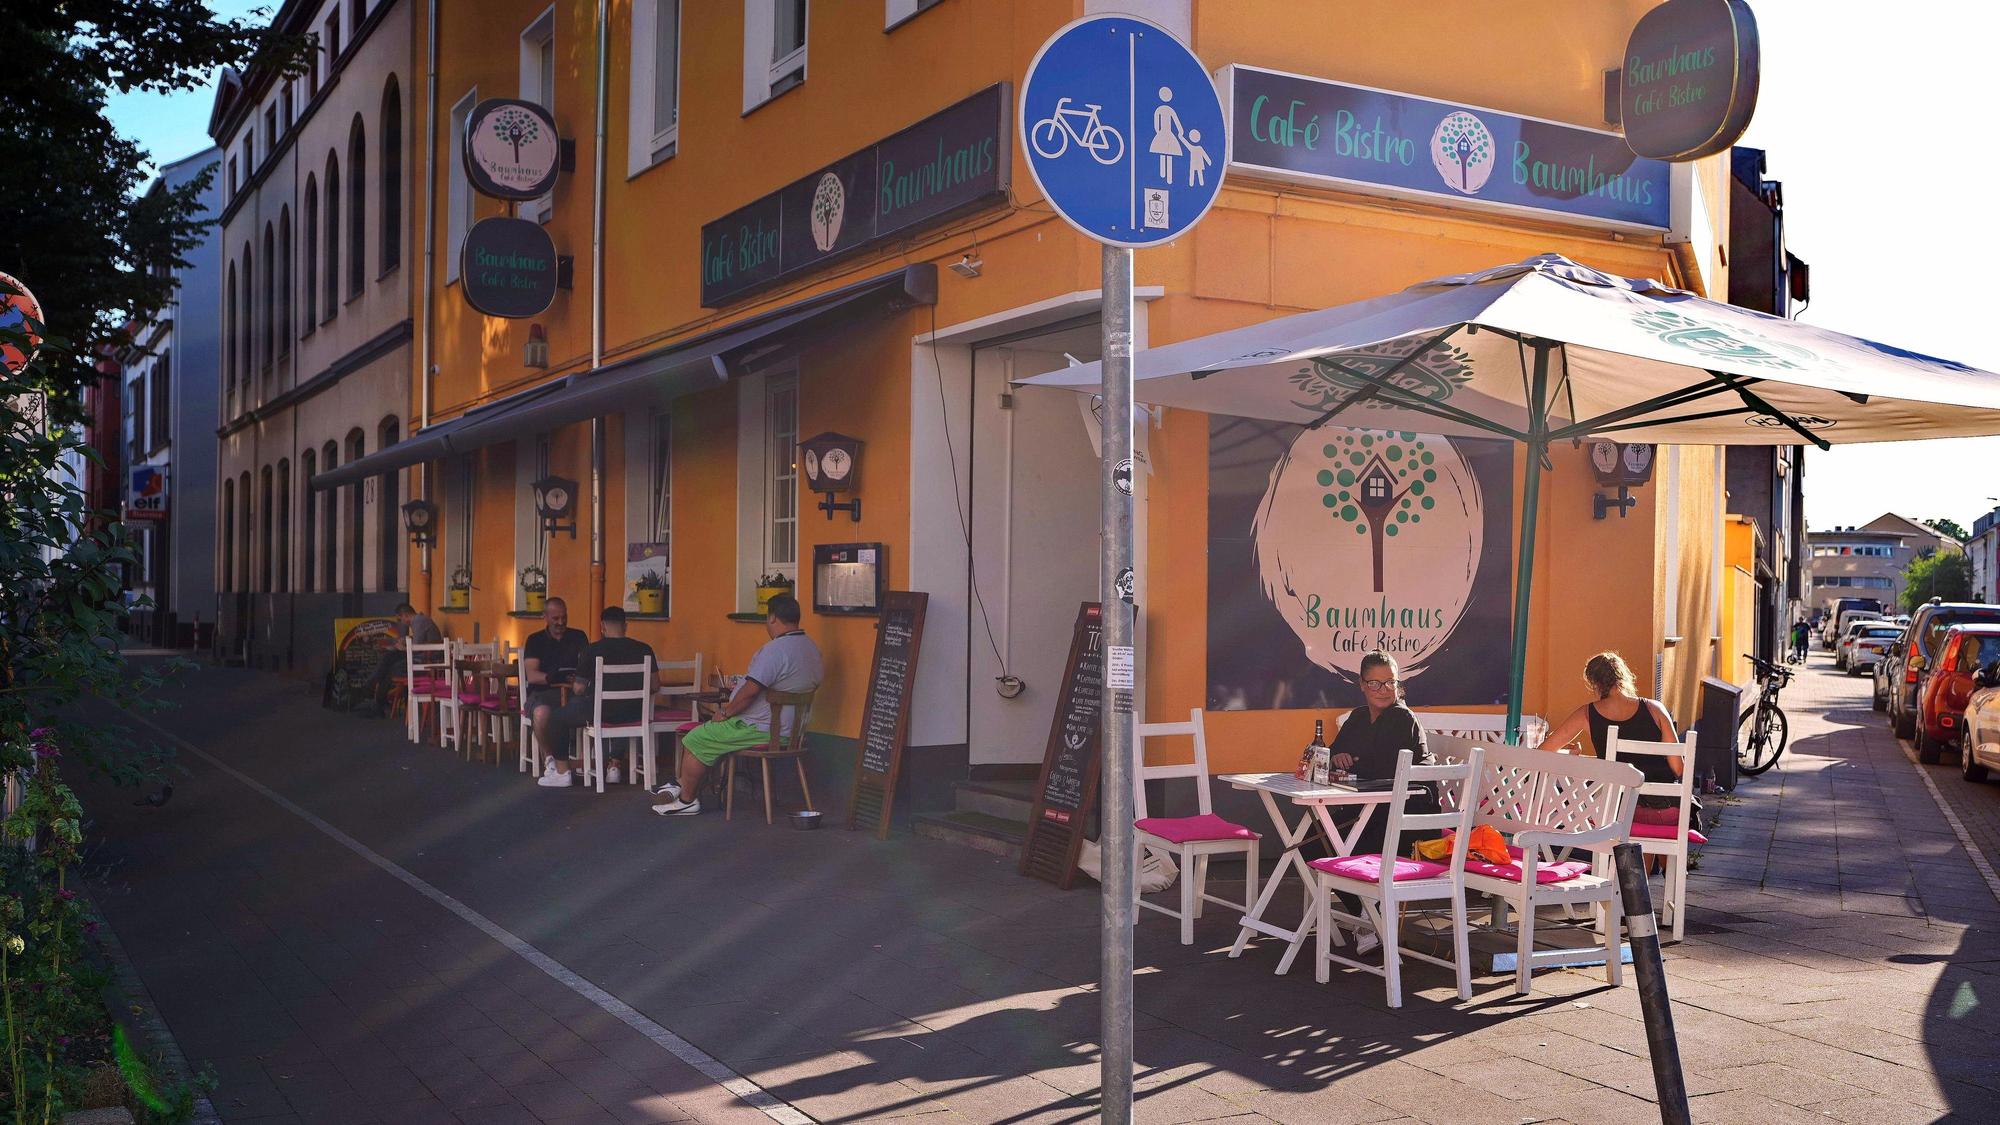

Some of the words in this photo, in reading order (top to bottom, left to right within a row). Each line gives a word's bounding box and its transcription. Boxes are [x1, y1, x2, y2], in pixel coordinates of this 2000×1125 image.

[1628, 44, 1715, 88] Baumhaus
[1668, 81, 1706, 108] Bistro
[1335, 109, 1415, 167] Bistro
[1513, 141, 1653, 206] Baumhaus
[738, 218, 778, 271] Bistro
[881, 136, 993, 216] Baumhaus
[475, 247, 546, 271] Baumhaus
[134, 497, 161, 509] elf
[365, 479, 375, 504] 28
[1306, 593, 1444, 629] Baumhaus
[1376, 630, 1421, 652] Bistro
